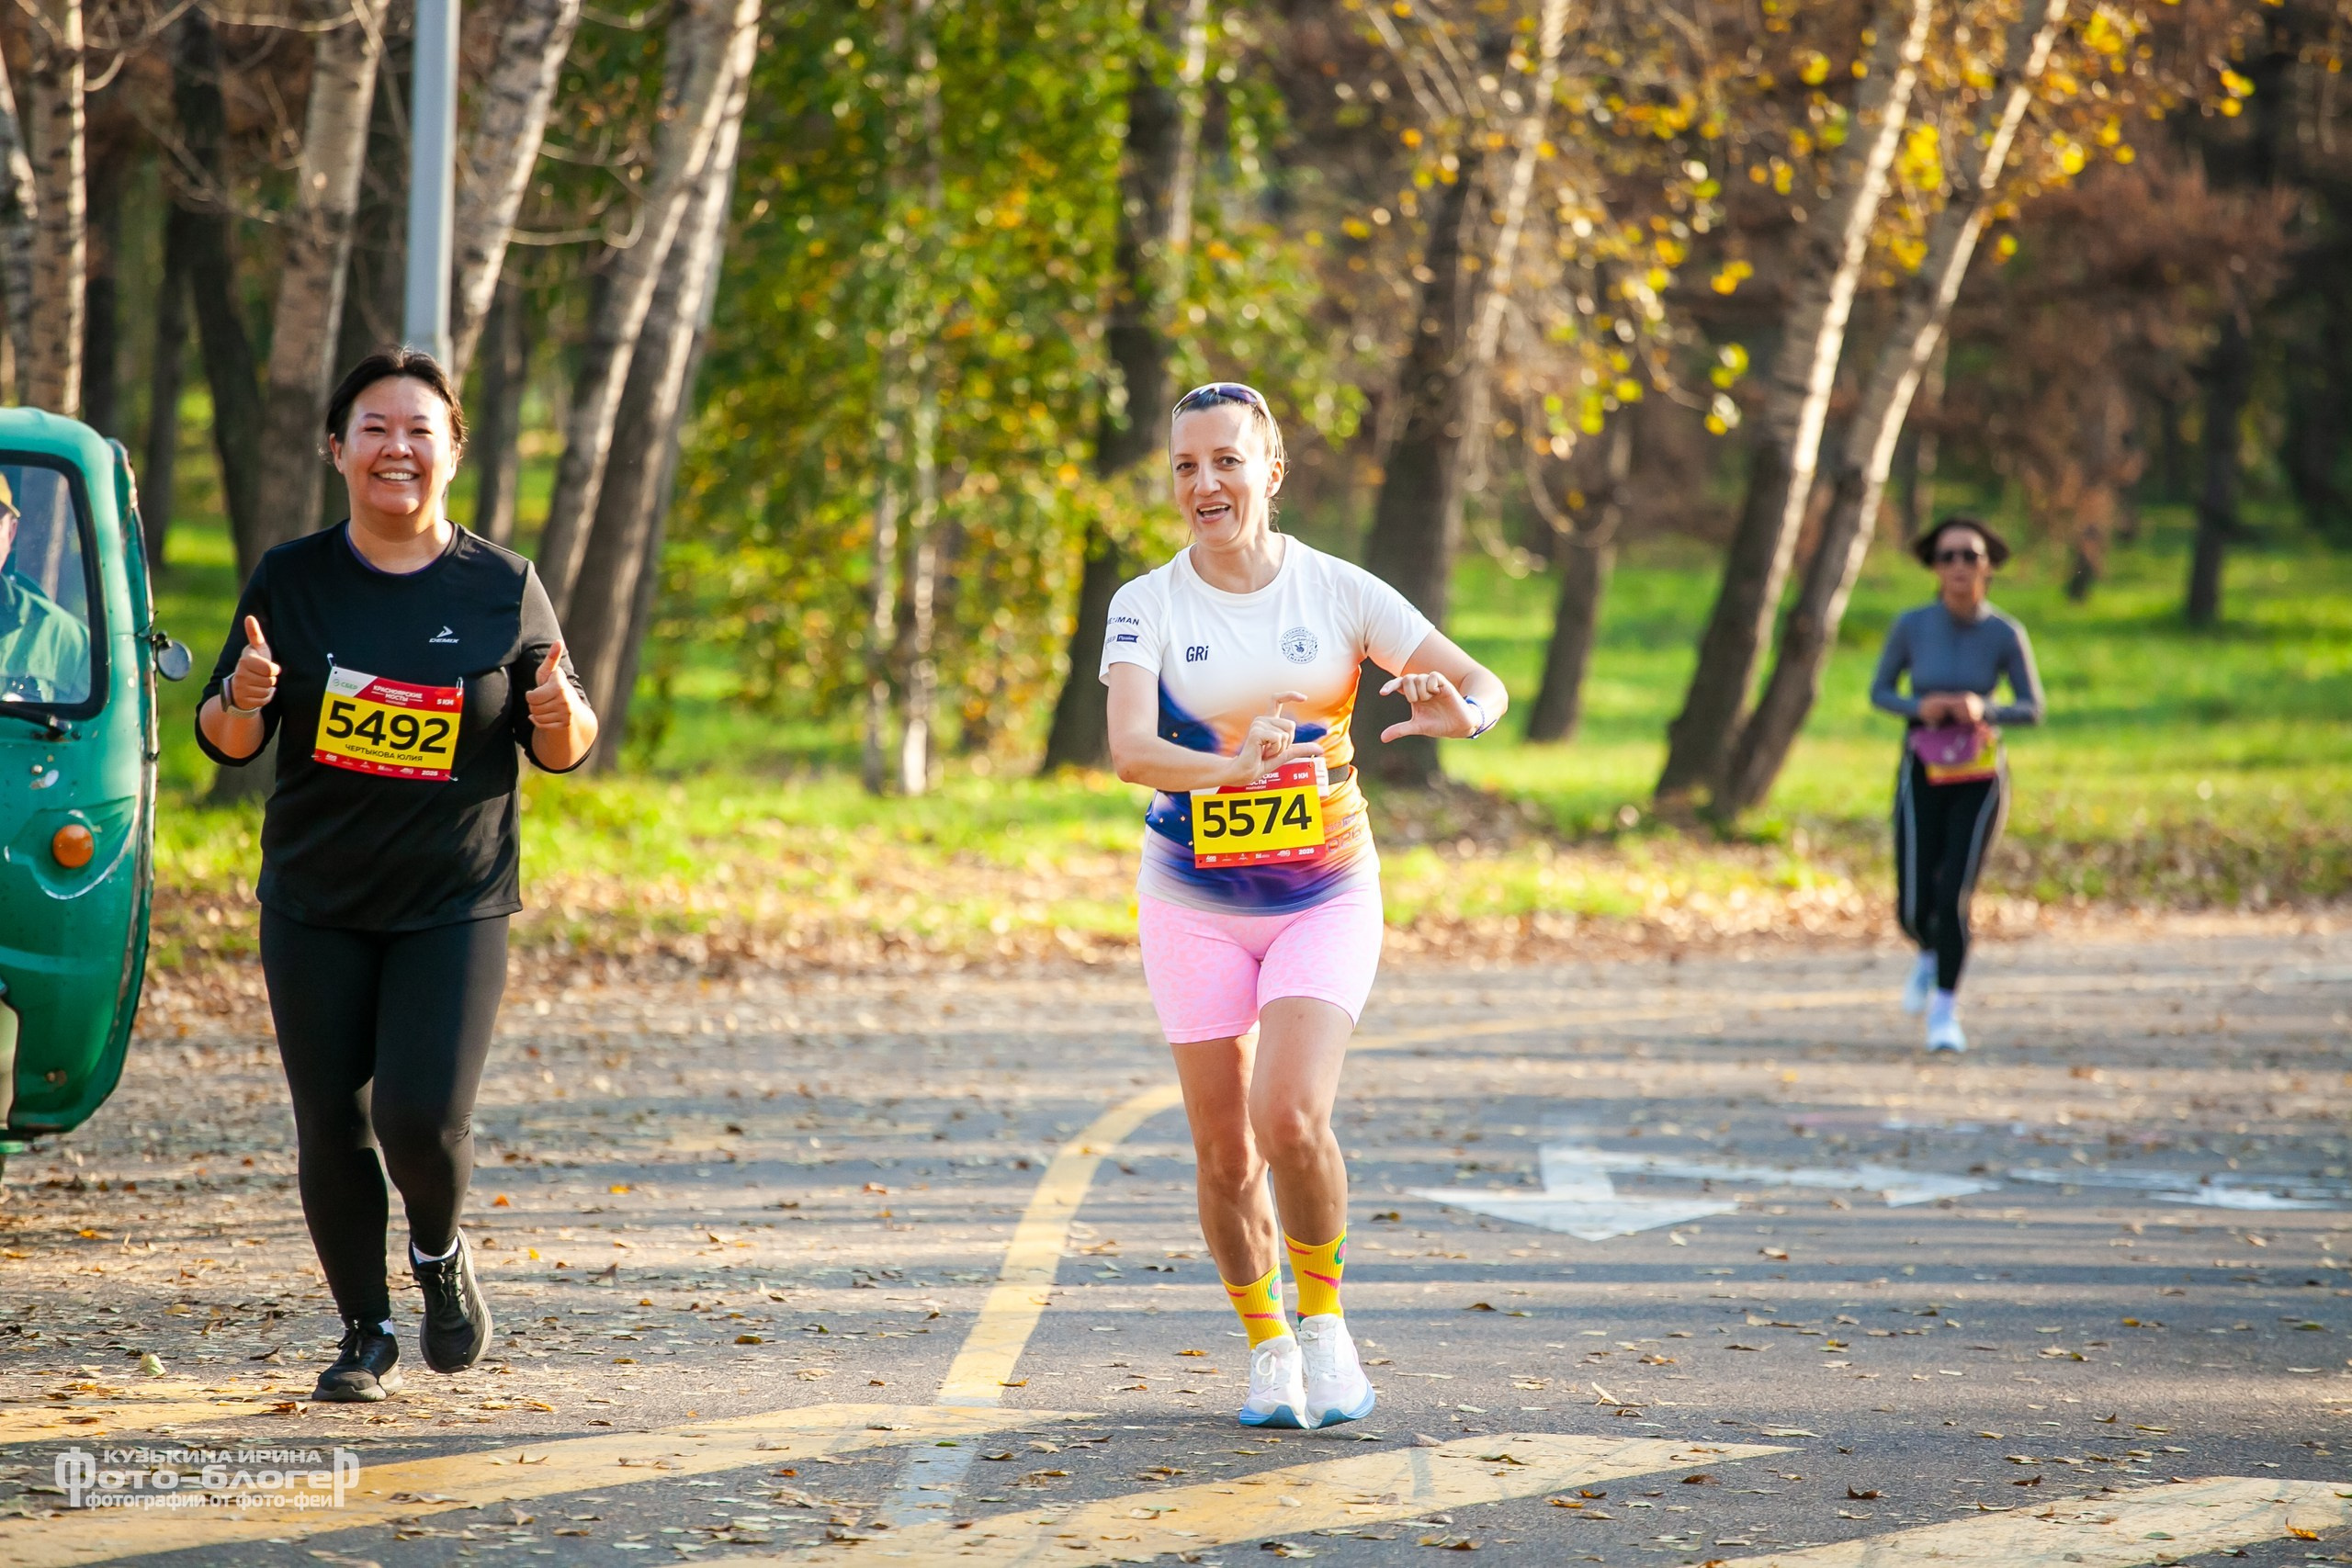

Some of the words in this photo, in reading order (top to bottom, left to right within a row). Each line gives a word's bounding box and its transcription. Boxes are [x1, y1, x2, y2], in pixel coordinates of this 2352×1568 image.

[1185, 645, 1209, 662] GRi
[326, 700, 451, 754] 5492
[345, 743, 395, 760] ЧЕРТЫКОВА
[397, 753, 424, 762] ЮЛИЯ
[1203, 794, 1313, 839] 5574
[1328, 824, 1362, 852] 026
